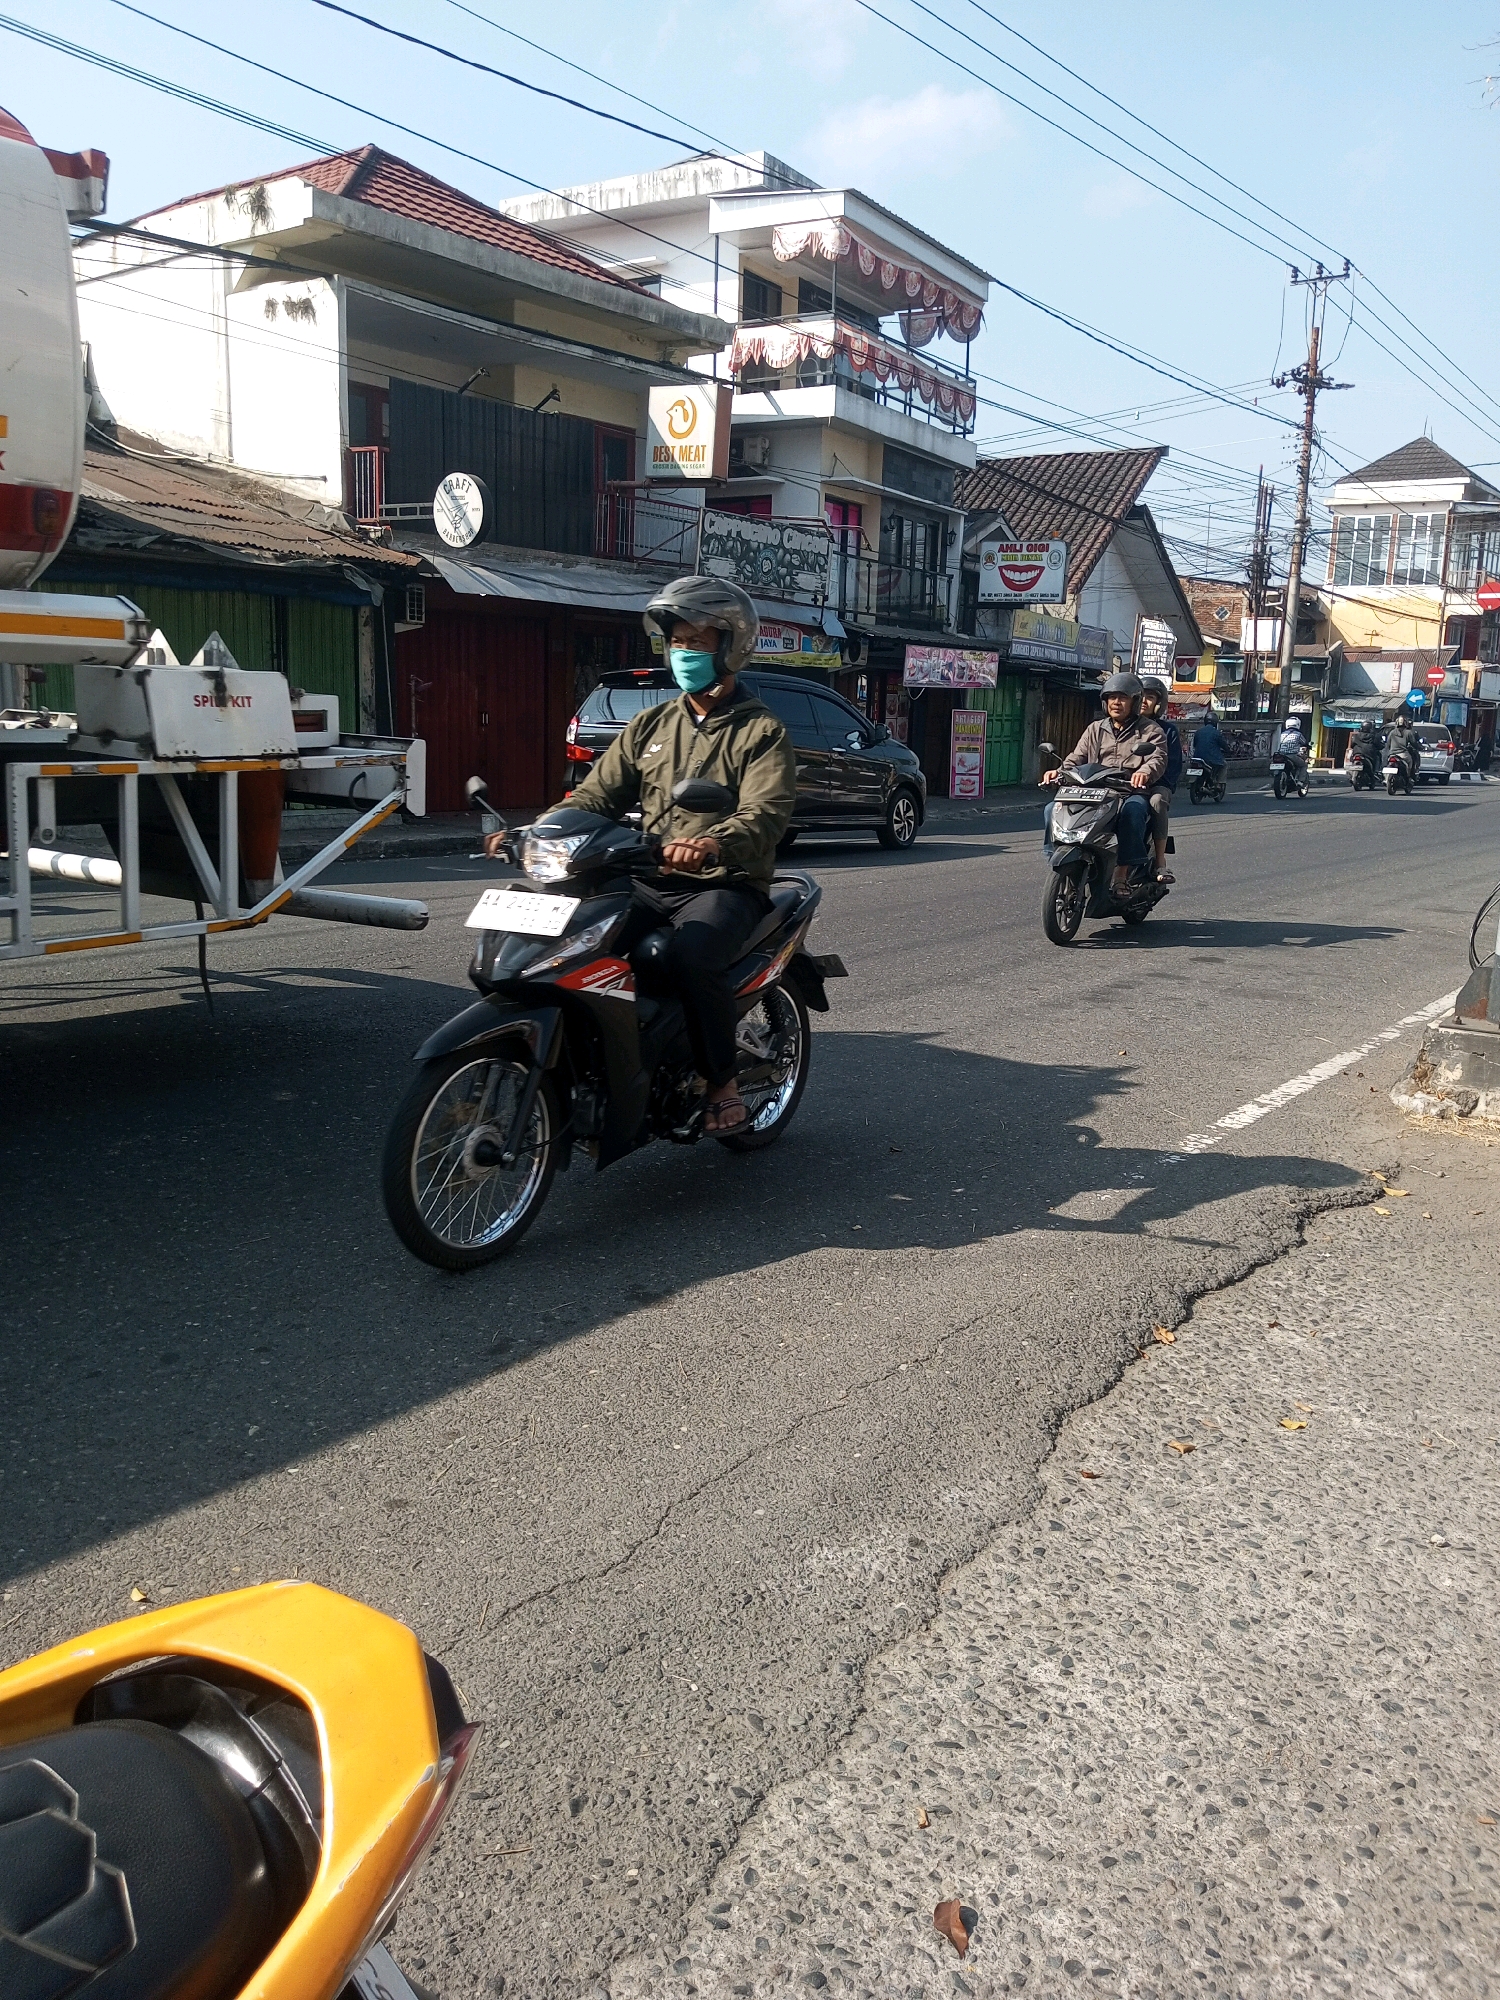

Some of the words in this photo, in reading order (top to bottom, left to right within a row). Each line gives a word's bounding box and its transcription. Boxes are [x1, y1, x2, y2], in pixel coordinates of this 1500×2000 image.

[653, 446, 676, 462] BEST
[679, 445, 706, 462] MEAT
[443, 477, 472, 495] CRAFT
[442, 527, 474, 544] BARBERSHOP
[998, 543, 1023, 553] AHLI
[1026, 543, 1050, 553] GIGI
[757, 625, 782, 639] ADURA
[760, 638, 777, 649] JAYA
[231, 695, 253, 708] KIT
